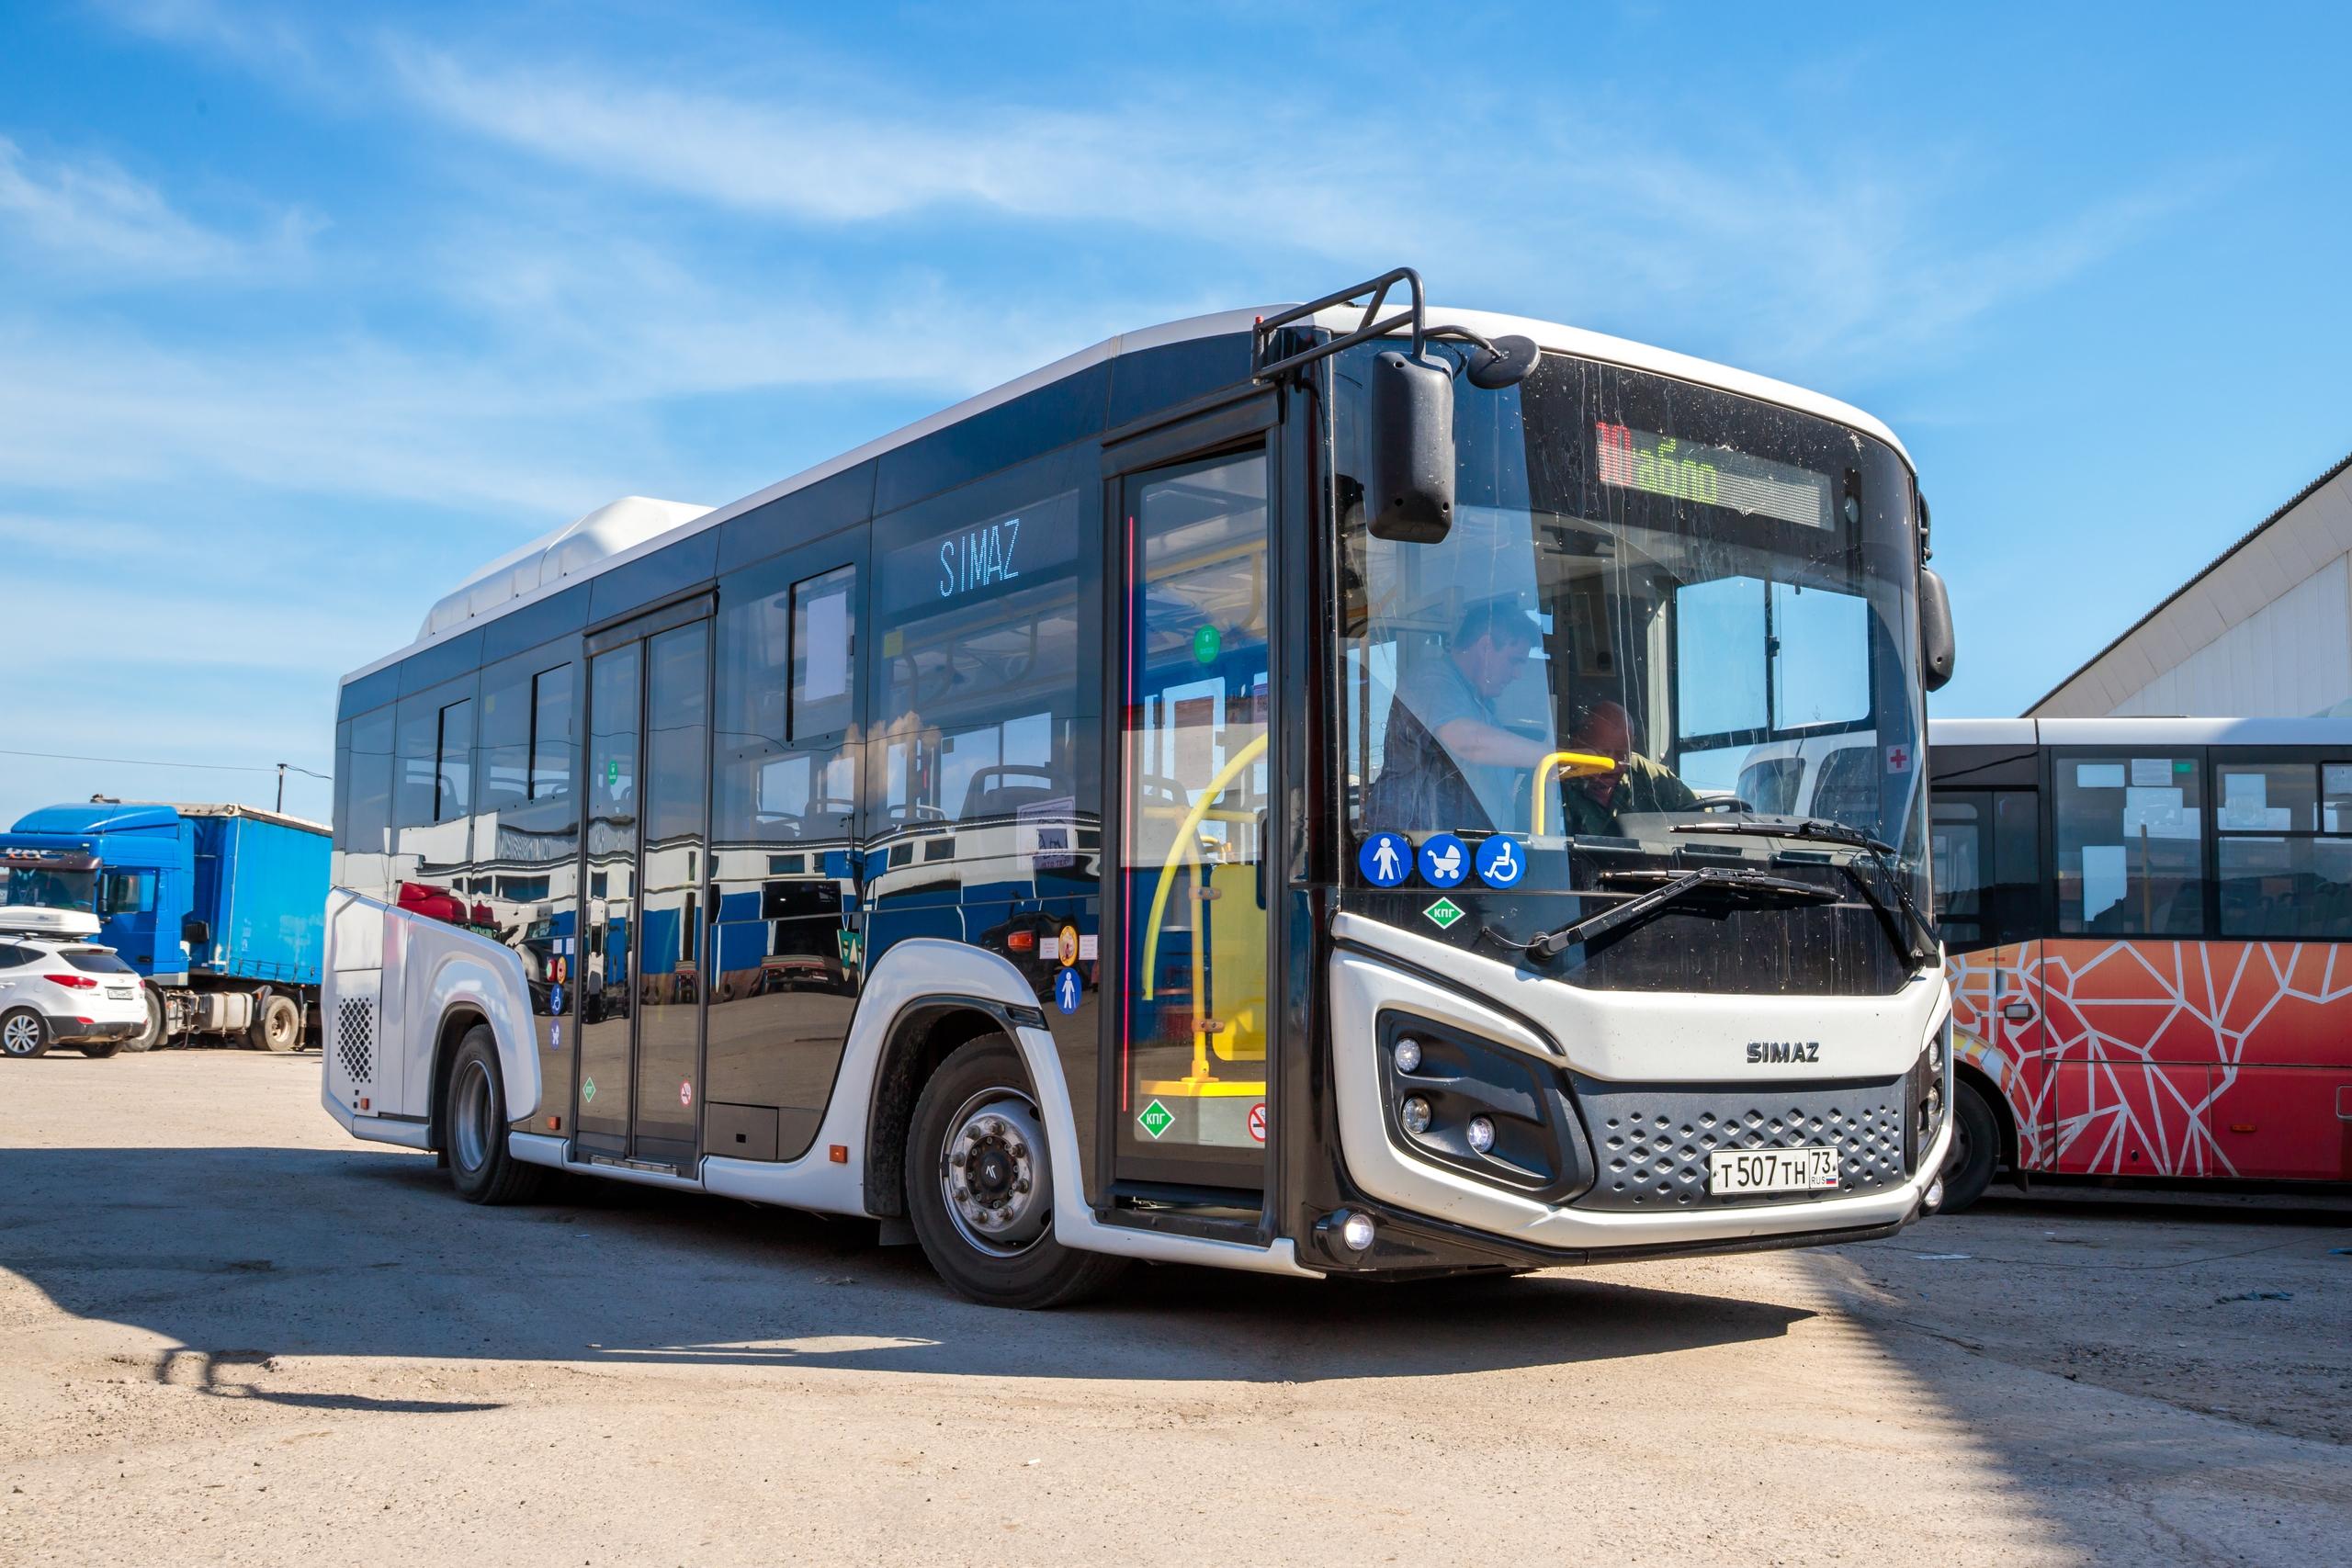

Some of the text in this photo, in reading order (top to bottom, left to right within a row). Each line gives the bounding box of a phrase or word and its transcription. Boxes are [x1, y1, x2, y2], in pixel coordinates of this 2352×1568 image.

[940, 518, 1020, 597] SIMAZ
[1434, 908, 1455, 919] КПГ
[1747, 1042, 1819, 1063] SIMAZ
[1146, 1112, 1166, 1125] КПГ
[1812, 1151, 1831, 1175] 73
[1811, 1176, 1826, 1185] RUS
